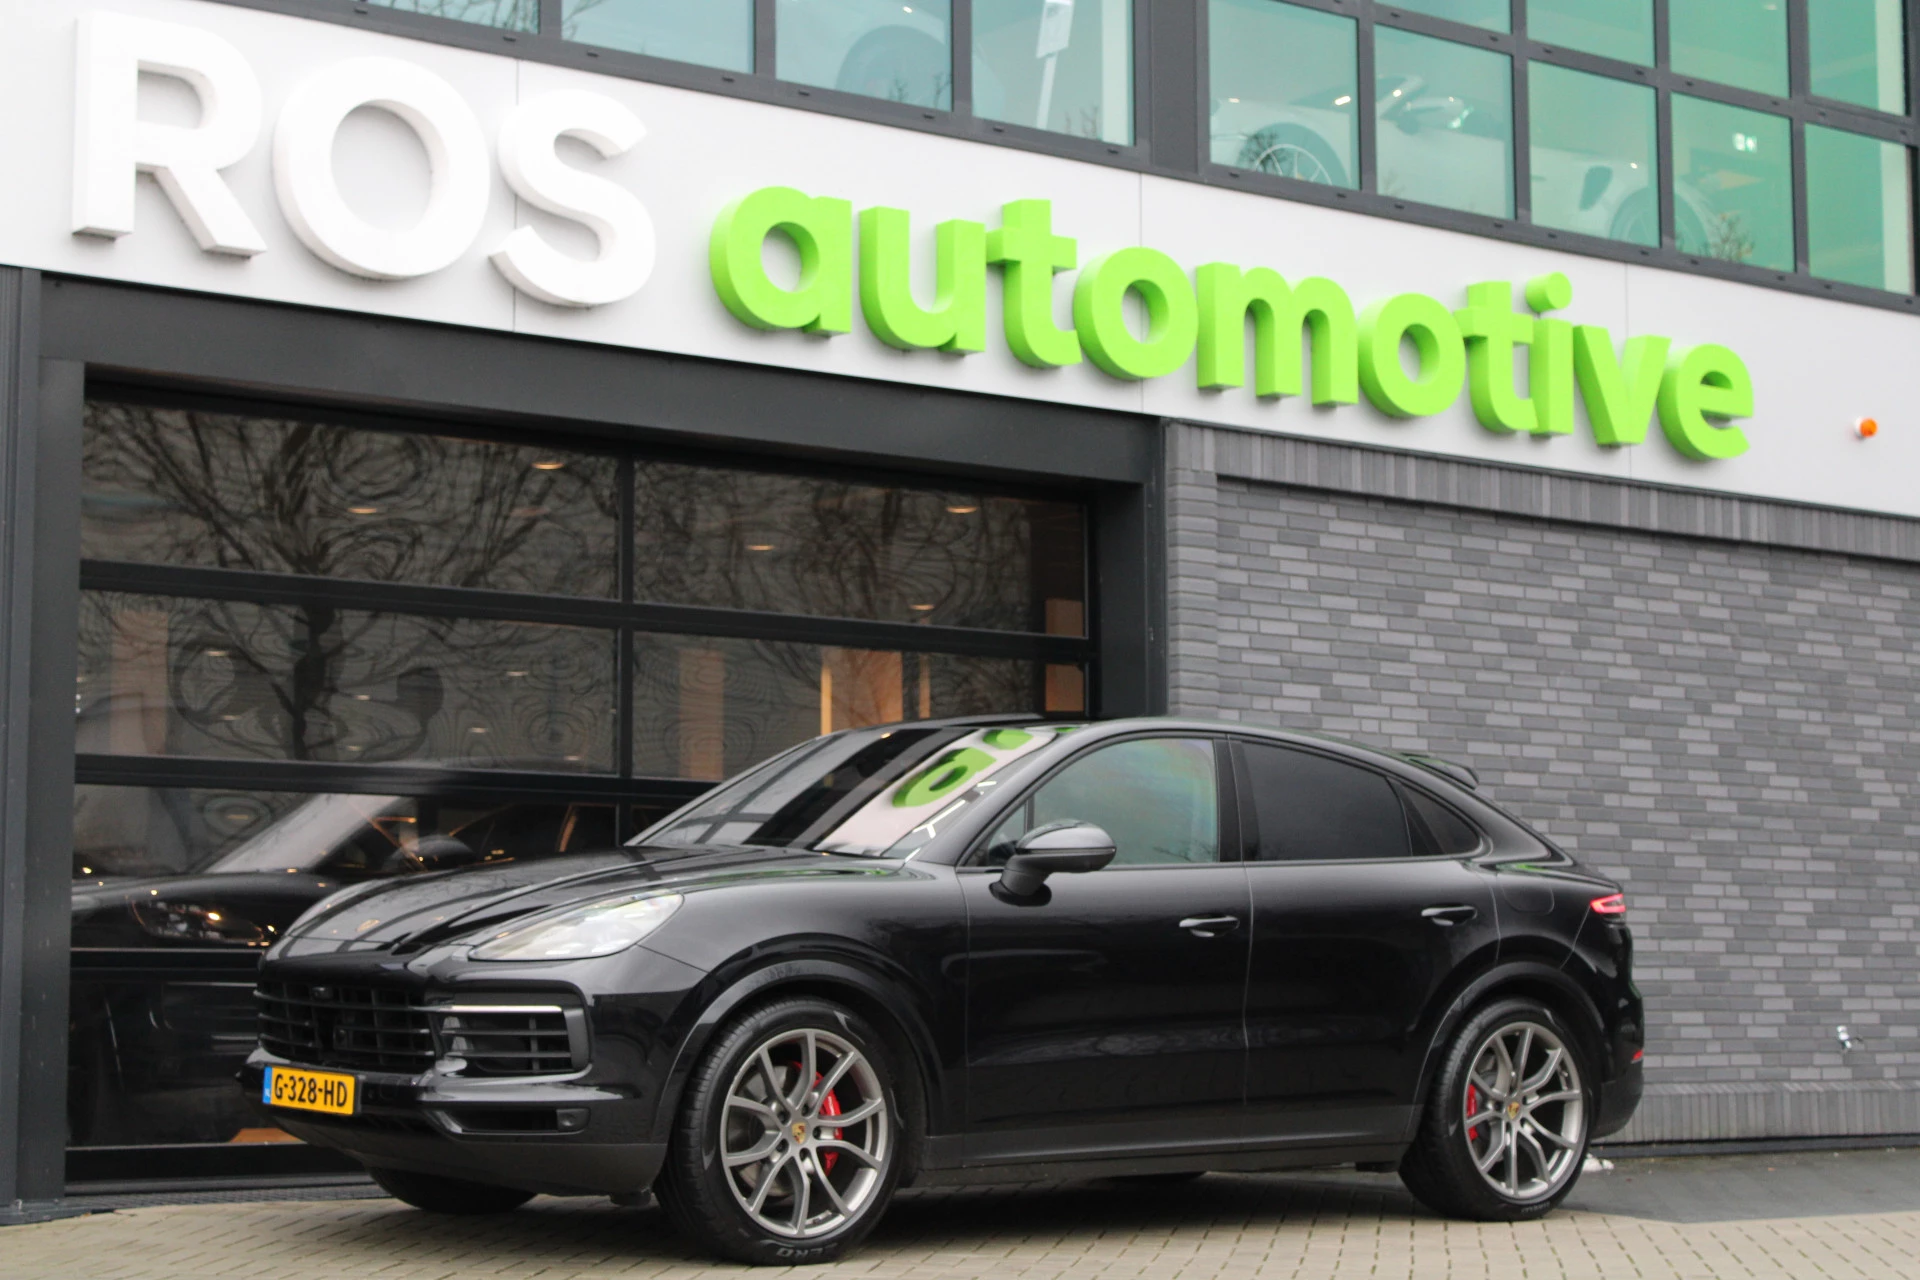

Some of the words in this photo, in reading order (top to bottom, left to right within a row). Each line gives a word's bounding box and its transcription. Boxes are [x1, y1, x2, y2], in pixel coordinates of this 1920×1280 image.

[72, 12, 656, 307] ROS
[709, 187, 1754, 461] automotive
[275, 1074, 348, 1107] G-328-HD
